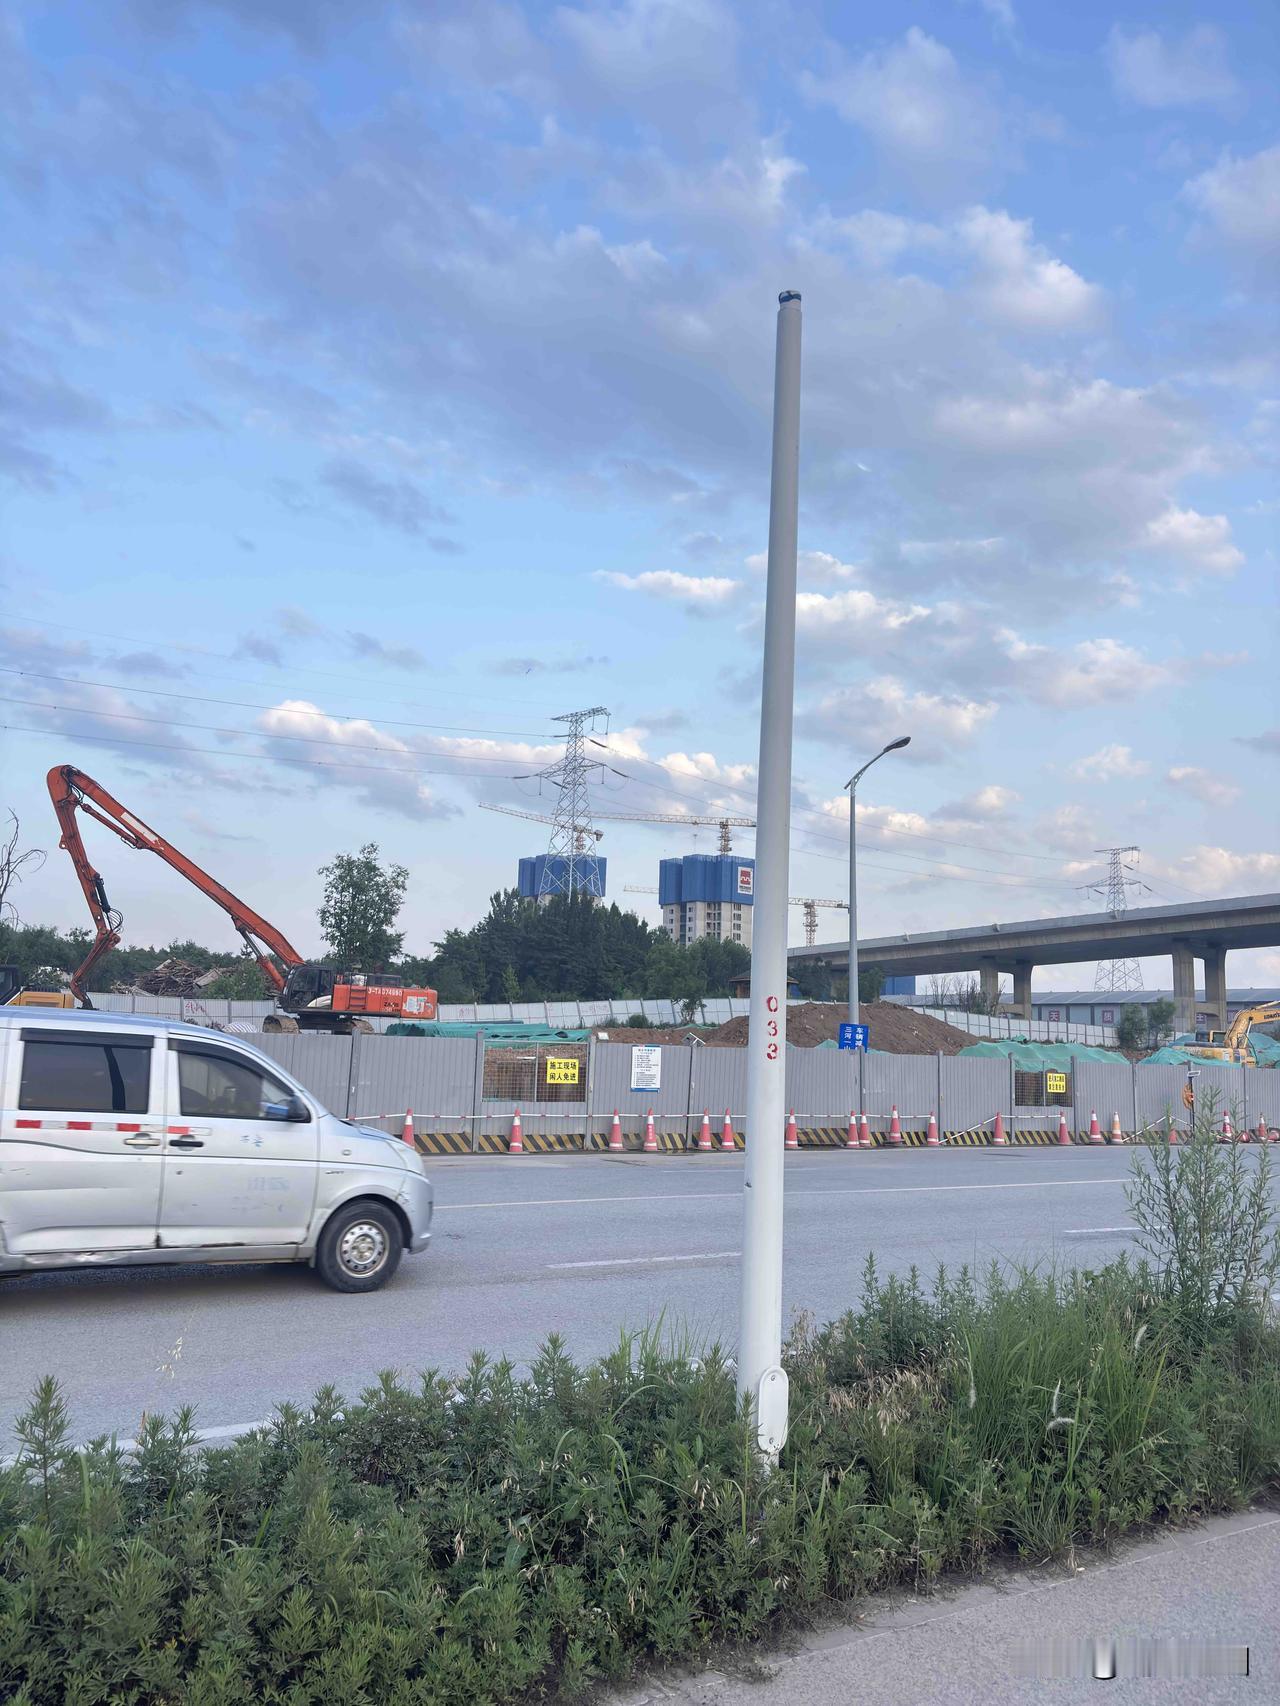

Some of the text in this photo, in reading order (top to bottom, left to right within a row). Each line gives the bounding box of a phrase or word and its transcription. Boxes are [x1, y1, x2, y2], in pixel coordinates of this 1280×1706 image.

[766, 996, 778, 1060] 033
[855, 1027, 863, 1050] 车辆减
[549, 1061, 577, 1070] 施工现场
[549, 1072, 576, 1081] 闲人免进
